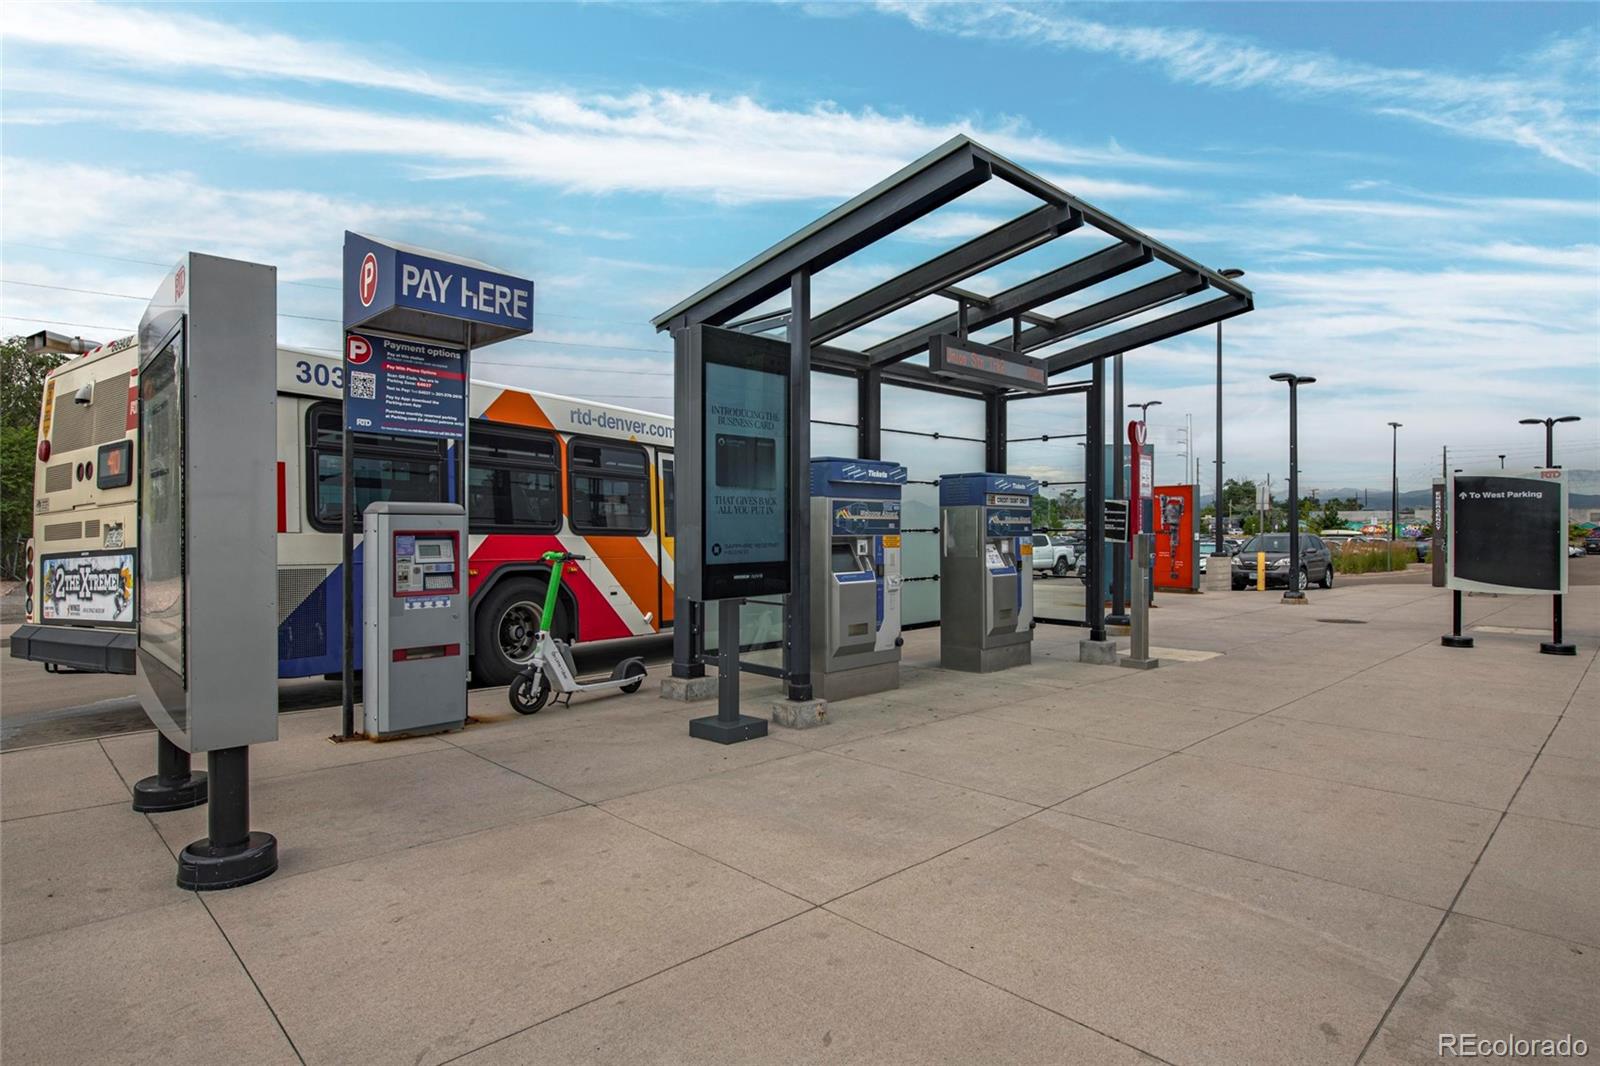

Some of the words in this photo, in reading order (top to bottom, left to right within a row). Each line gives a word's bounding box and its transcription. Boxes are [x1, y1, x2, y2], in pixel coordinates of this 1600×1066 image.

[364, 262, 373, 298] P
[402, 263, 453, 304] PAY
[350, 340, 367, 360] P
[384, 340, 425, 354] Payment
[427, 348, 460, 360] options
[356, 418, 372, 426] RTD
[712, 405, 764, 420] INTRODUCING
[766, 411, 780, 422] THE
[570, 408, 674, 438] rtd-denver.com
[718, 416, 753, 428] BUSINESS
[754, 420, 774, 430] CARD
[1136, 424, 1146, 445] V
[868, 470, 888, 478] Tickets
[714, 496, 735, 505] THAT
[736, 496, 758, 506] GIVES
[759, 497, 777, 506] BACK
[1469, 491, 1480, 499] To
[1482, 491, 1505, 499] West
[1507, 491, 1543, 499] Parking
[719, 506, 733, 514] ALL
[734, 506, 748, 514] YOU
[751, 506, 764, 514] PUT
[766, 506, 774, 514] IN
[56, 568, 65, 598] 2
[65, 575, 80, 591] THE
